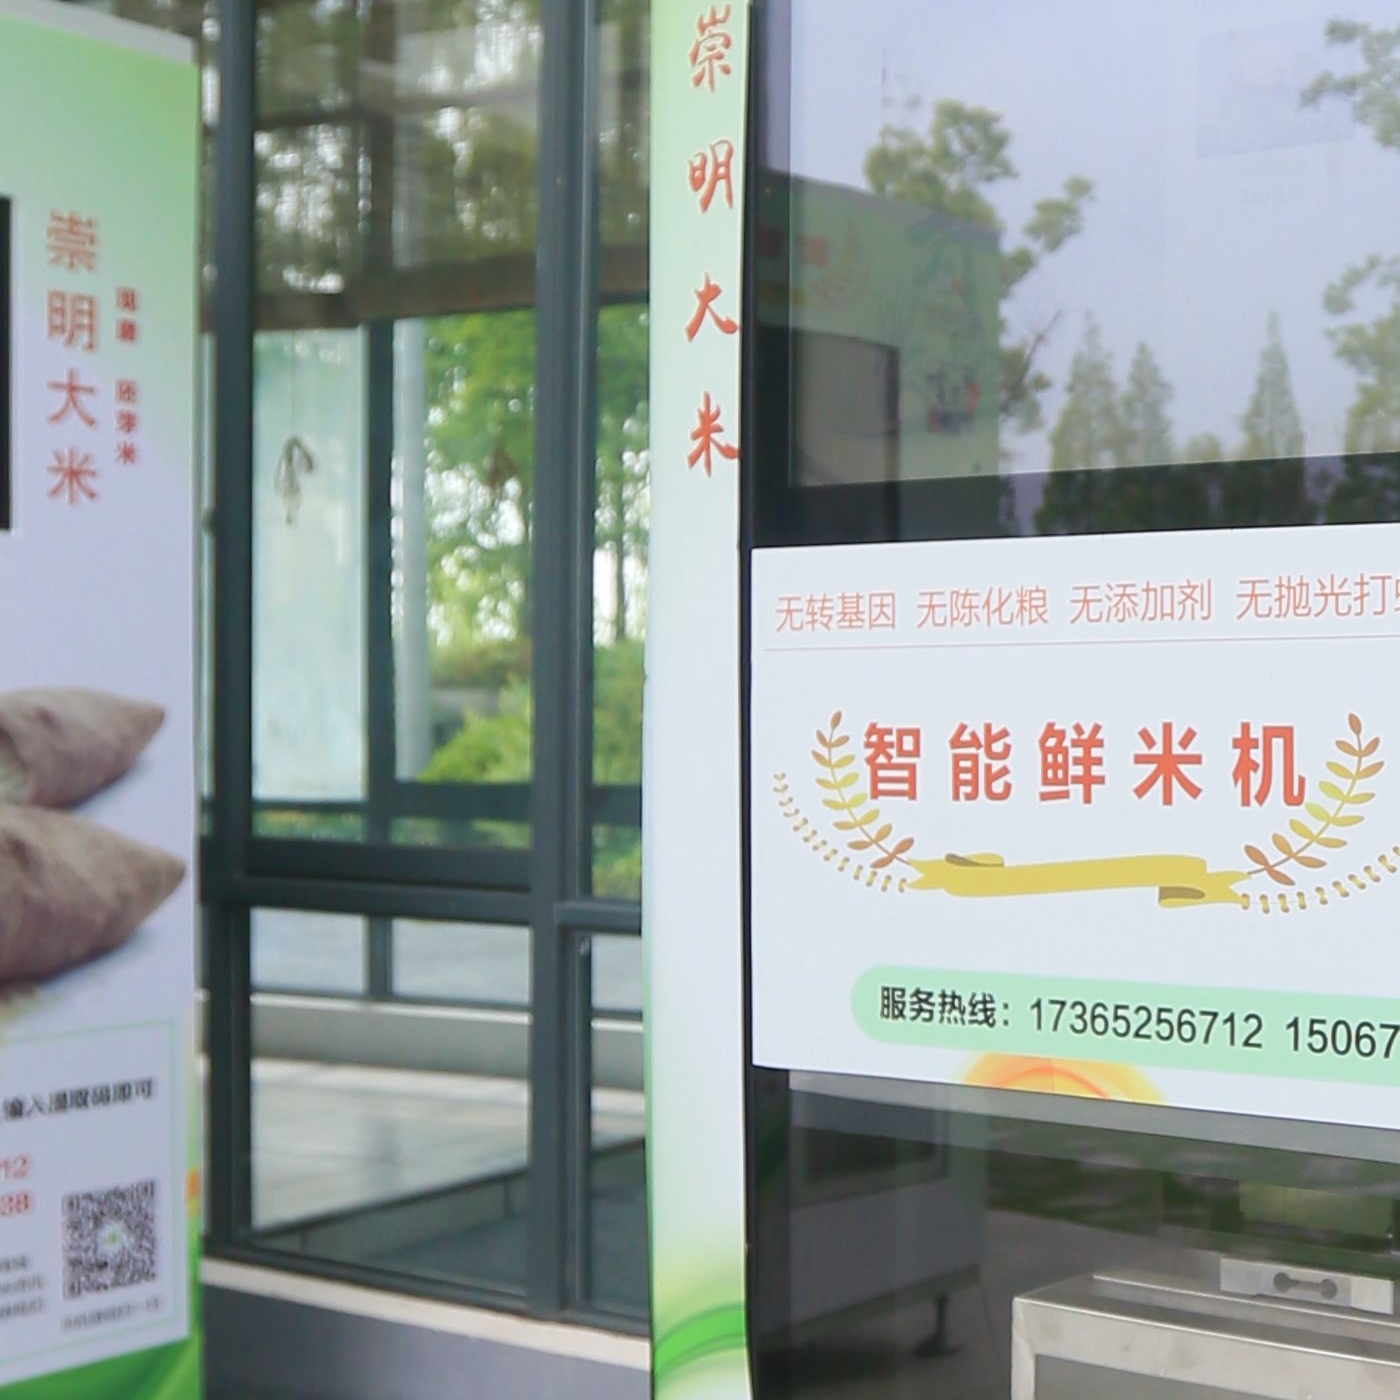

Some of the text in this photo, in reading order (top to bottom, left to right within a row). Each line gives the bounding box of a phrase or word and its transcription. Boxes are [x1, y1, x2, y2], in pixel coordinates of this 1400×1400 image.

[685, 4, 740, 477] 崇明大米
[46, 209, 97, 505] 崇明大米
[775, 591, 898, 633] 无转基因
[916, 586, 1049, 628] 无陈化粮
[1069, 579, 1213, 626] 无添加剂
[863, 721, 1306, 808] 智能鲜米机
[1029, 998, 1263, 1050] 17365256712
